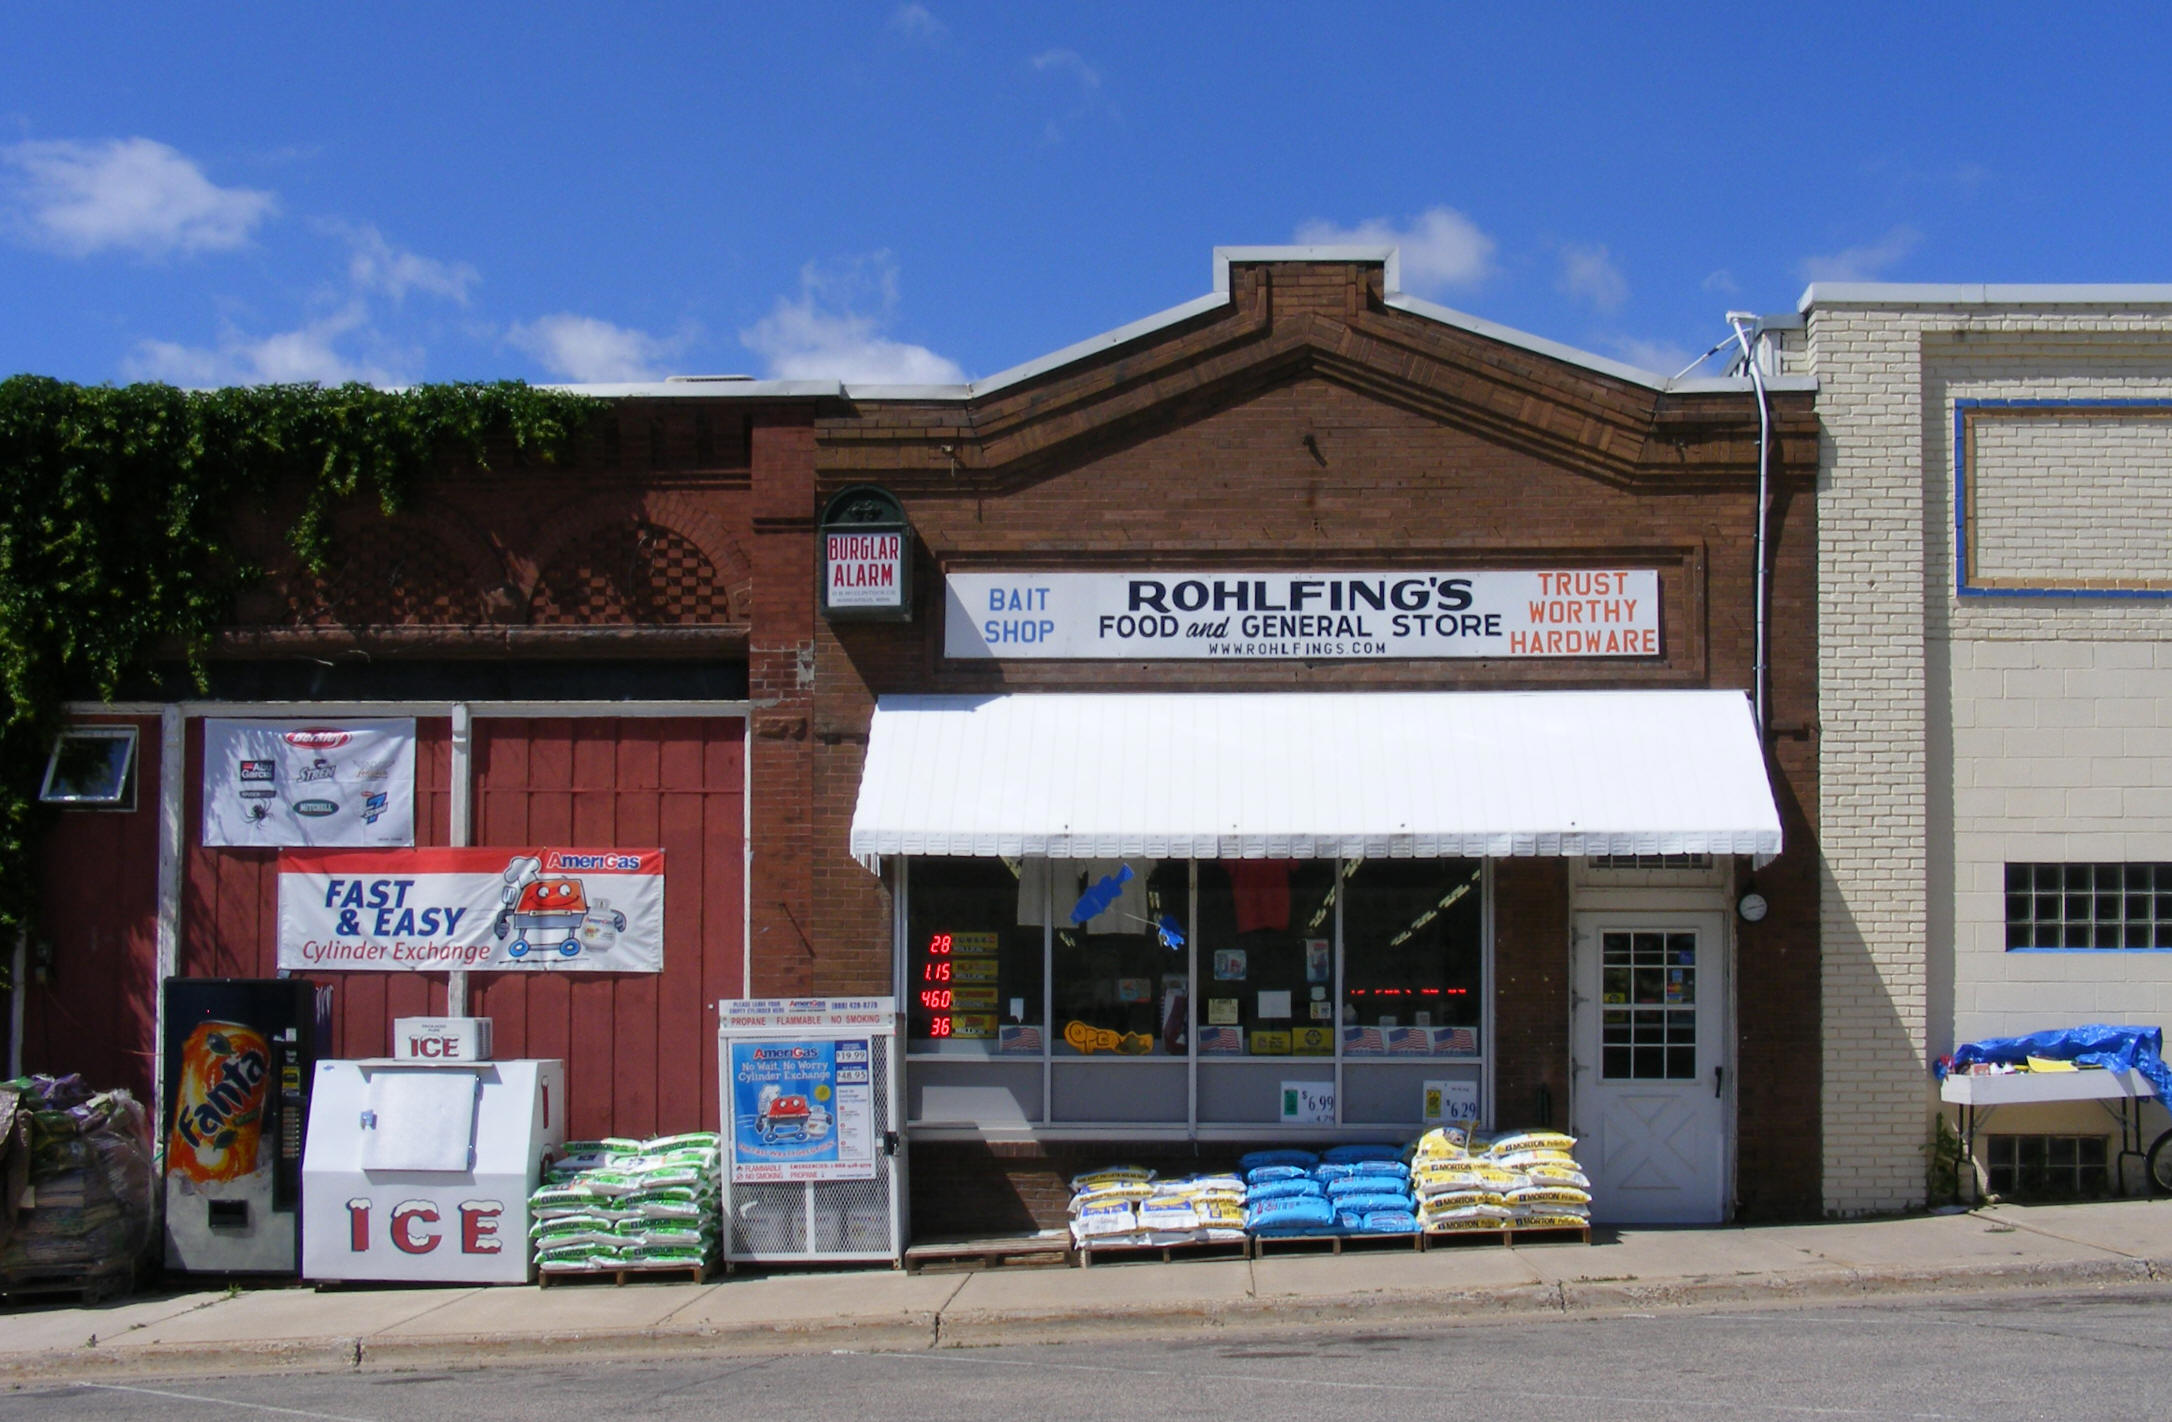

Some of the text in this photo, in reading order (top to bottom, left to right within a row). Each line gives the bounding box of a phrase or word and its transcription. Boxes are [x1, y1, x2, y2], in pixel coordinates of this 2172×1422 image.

[828, 535, 899, 561] BURGLAR
[833, 563, 893, 587] ALARM
[1537, 572, 1629, 597] TRUST
[988, 587, 1051, 612] BAIT
[1127, 576, 1474, 614] ROHLFING'S
[1528, 599, 1638, 624] WORTHY
[984, 620, 1055, 644] SHOP
[1099, 614, 1503, 639] FOOD and GENERAL STORE
[1509, 628, 1657, 655] HARDWARE
[547, 851, 642, 871] AmeriGas
[324, 879, 415, 909] FAST
[335, 906, 467, 937] & EASY
[302, 940, 491, 966] Cylinder Exchange
[930, 934, 952, 953] 28
[921, 989, 952, 1008] 460
[731, 1014, 880, 1026] PROPANE FLAMMABLE NO SMOKING
[930, 1016, 951, 1036] 36
[408, 1033, 460, 1058] ICE
[753, 1047, 819, 1060] AmeriGas
[738, 1069, 831, 1084] Cylinder Exchange
[742, 1062, 755, 1072] No
[783, 1061, 796, 1070] No
[798, 1060, 829, 1073] Worry
[177, 1050, 267, 1149] Fanta
[344, 1196, 505, 1255] ICE
